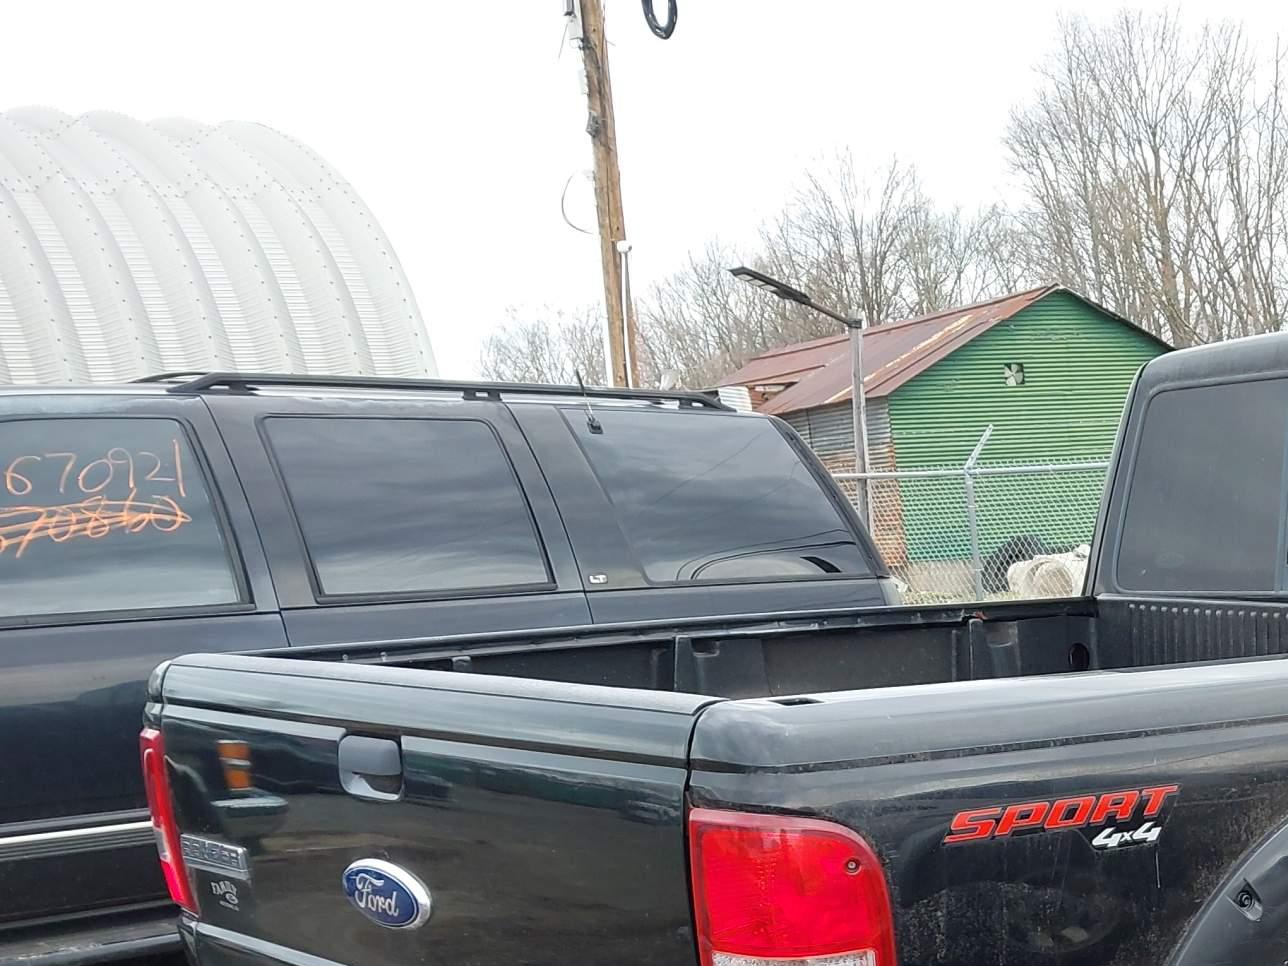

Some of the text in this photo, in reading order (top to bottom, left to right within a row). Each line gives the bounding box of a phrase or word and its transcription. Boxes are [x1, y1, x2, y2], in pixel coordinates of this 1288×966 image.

[4, 438, 187, 496] 670921
[943, 784, 1180, 844] SPORT
[1091, 821, 1162, 848] 4x4
[350, 872, 400, 917] Ford
